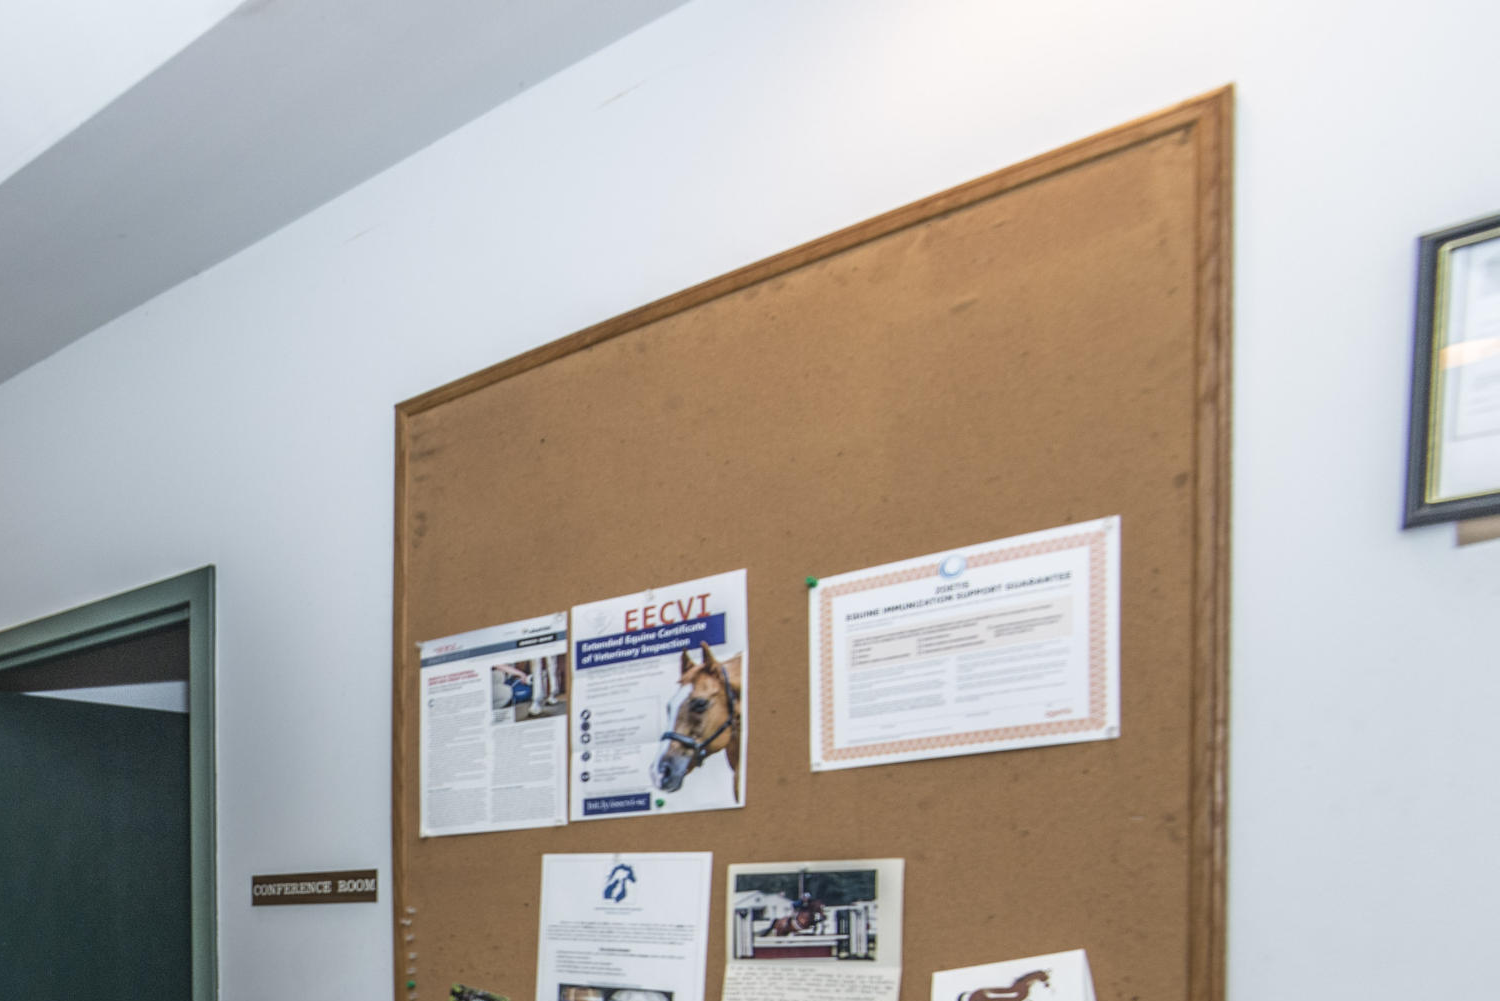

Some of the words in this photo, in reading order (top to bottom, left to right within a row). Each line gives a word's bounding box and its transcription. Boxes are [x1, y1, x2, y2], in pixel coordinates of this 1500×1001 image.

[845, 606, 881, 622] EQUINE
[956, 583, 1002, 600] SUPPORT
[1005, 570, 1072, 590] GUARANTEE
[624, 593, 712, 633] EECVI
[581, 633, 624, 654] Extended
[625, 628, 656, 645] Equine
[657, 621, 707, 640] Certificate
[581, 654, 593, 665] of
[593, 645, 640, 663] Veterinary
[641, 637, 691, 655] Inspection
[253, 880, 333, 897] CONFERENCE
[337, 878, 376, 893] ROOM
